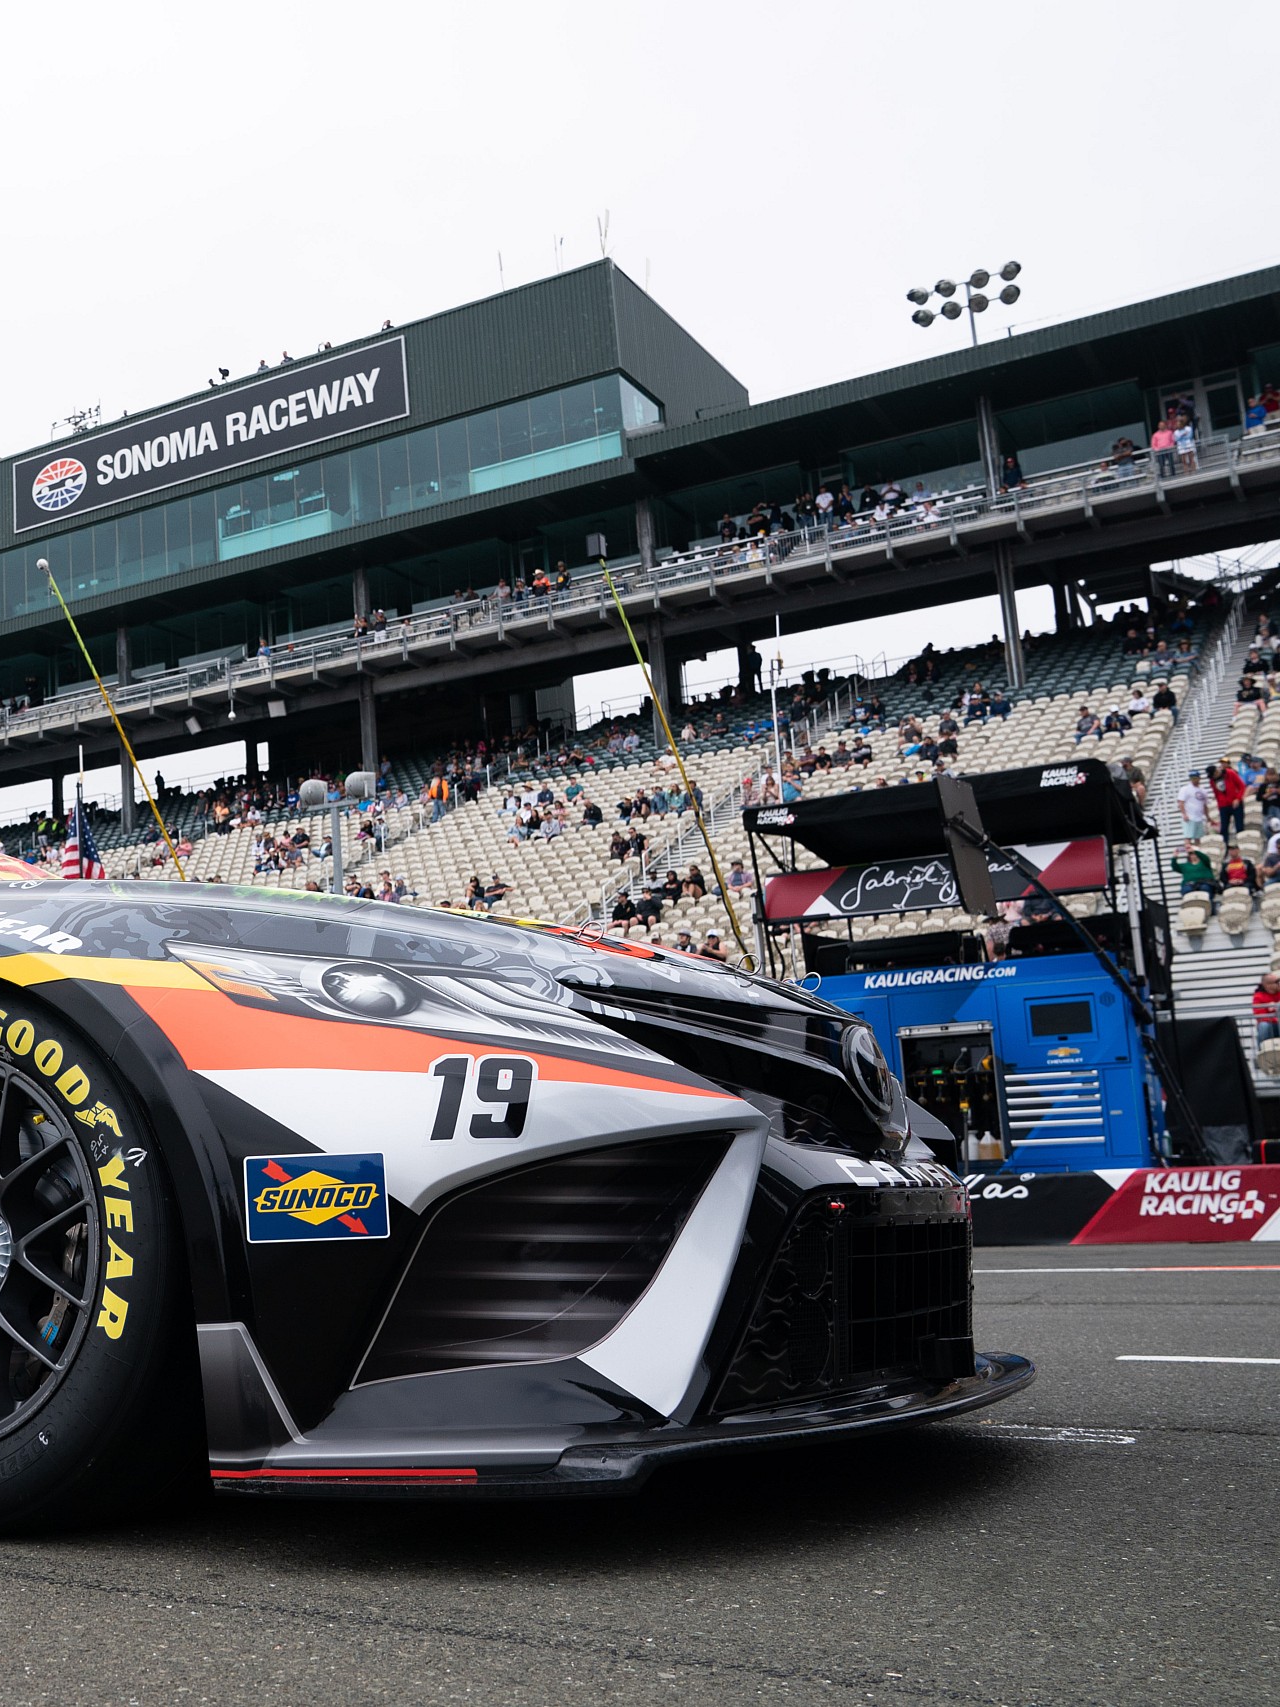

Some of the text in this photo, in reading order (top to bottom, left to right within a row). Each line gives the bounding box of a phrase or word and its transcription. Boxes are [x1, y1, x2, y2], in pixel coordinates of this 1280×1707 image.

[96, 367, 381, 486] SONOMA RACEWAY
[1040, 776, 1077, 787] RACING
[1042, 766, 1078, 778] KAULIG
[757, 808, 788, 817] KAULIG
[864, 965, 1017, 989] KAULIGRACING.COM
[429, 1057, 533, 1141] 19
[1144, 1169, 1241, 1193] KAULIG
[259, 1186, 373, 1211] SUNOCO
[1140, 1192, 1240, 1216] RACING
